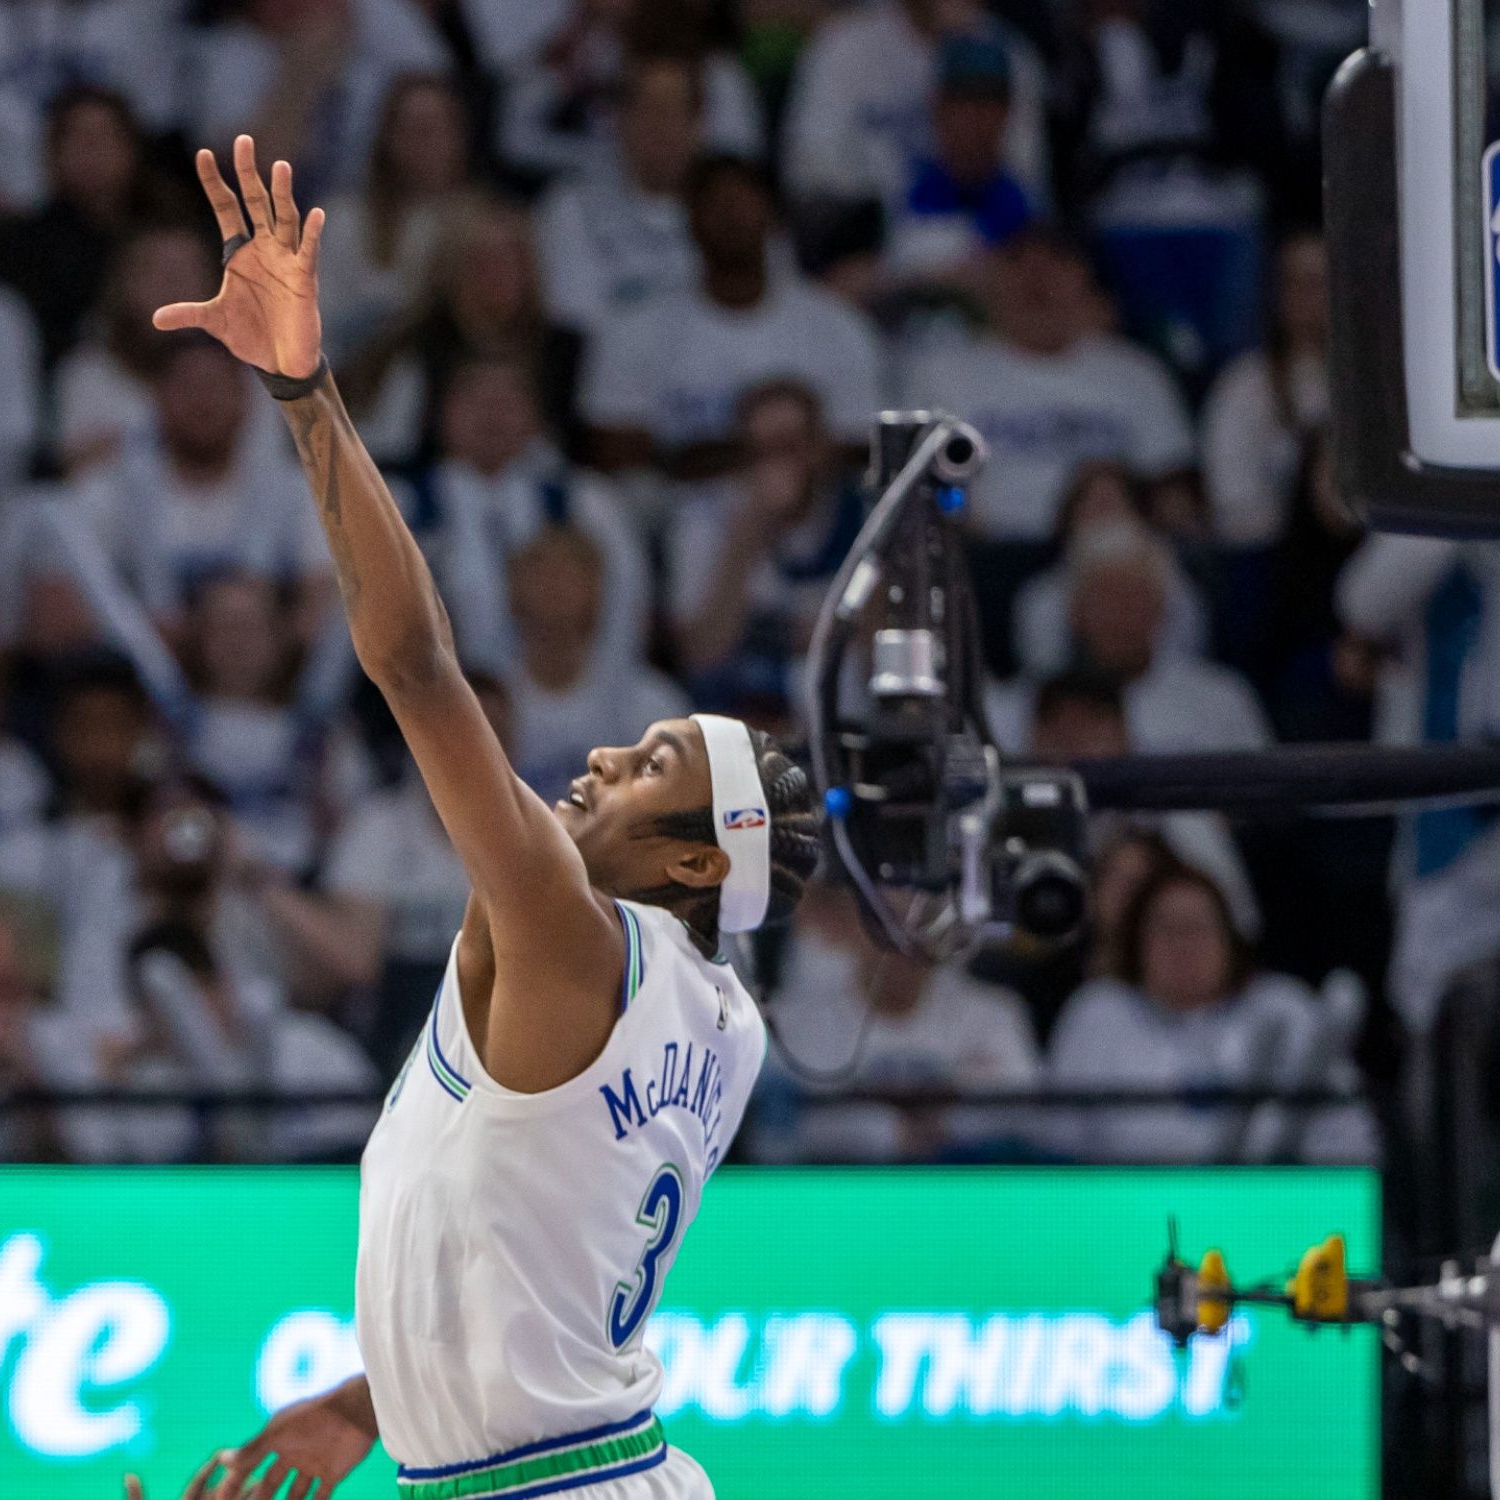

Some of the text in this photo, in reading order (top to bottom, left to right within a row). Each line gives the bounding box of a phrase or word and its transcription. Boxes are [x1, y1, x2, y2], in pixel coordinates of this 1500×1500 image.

[604, 1162, 685, 1354] 3
[643, 1311, 1252, 1420] OUR THIRST
